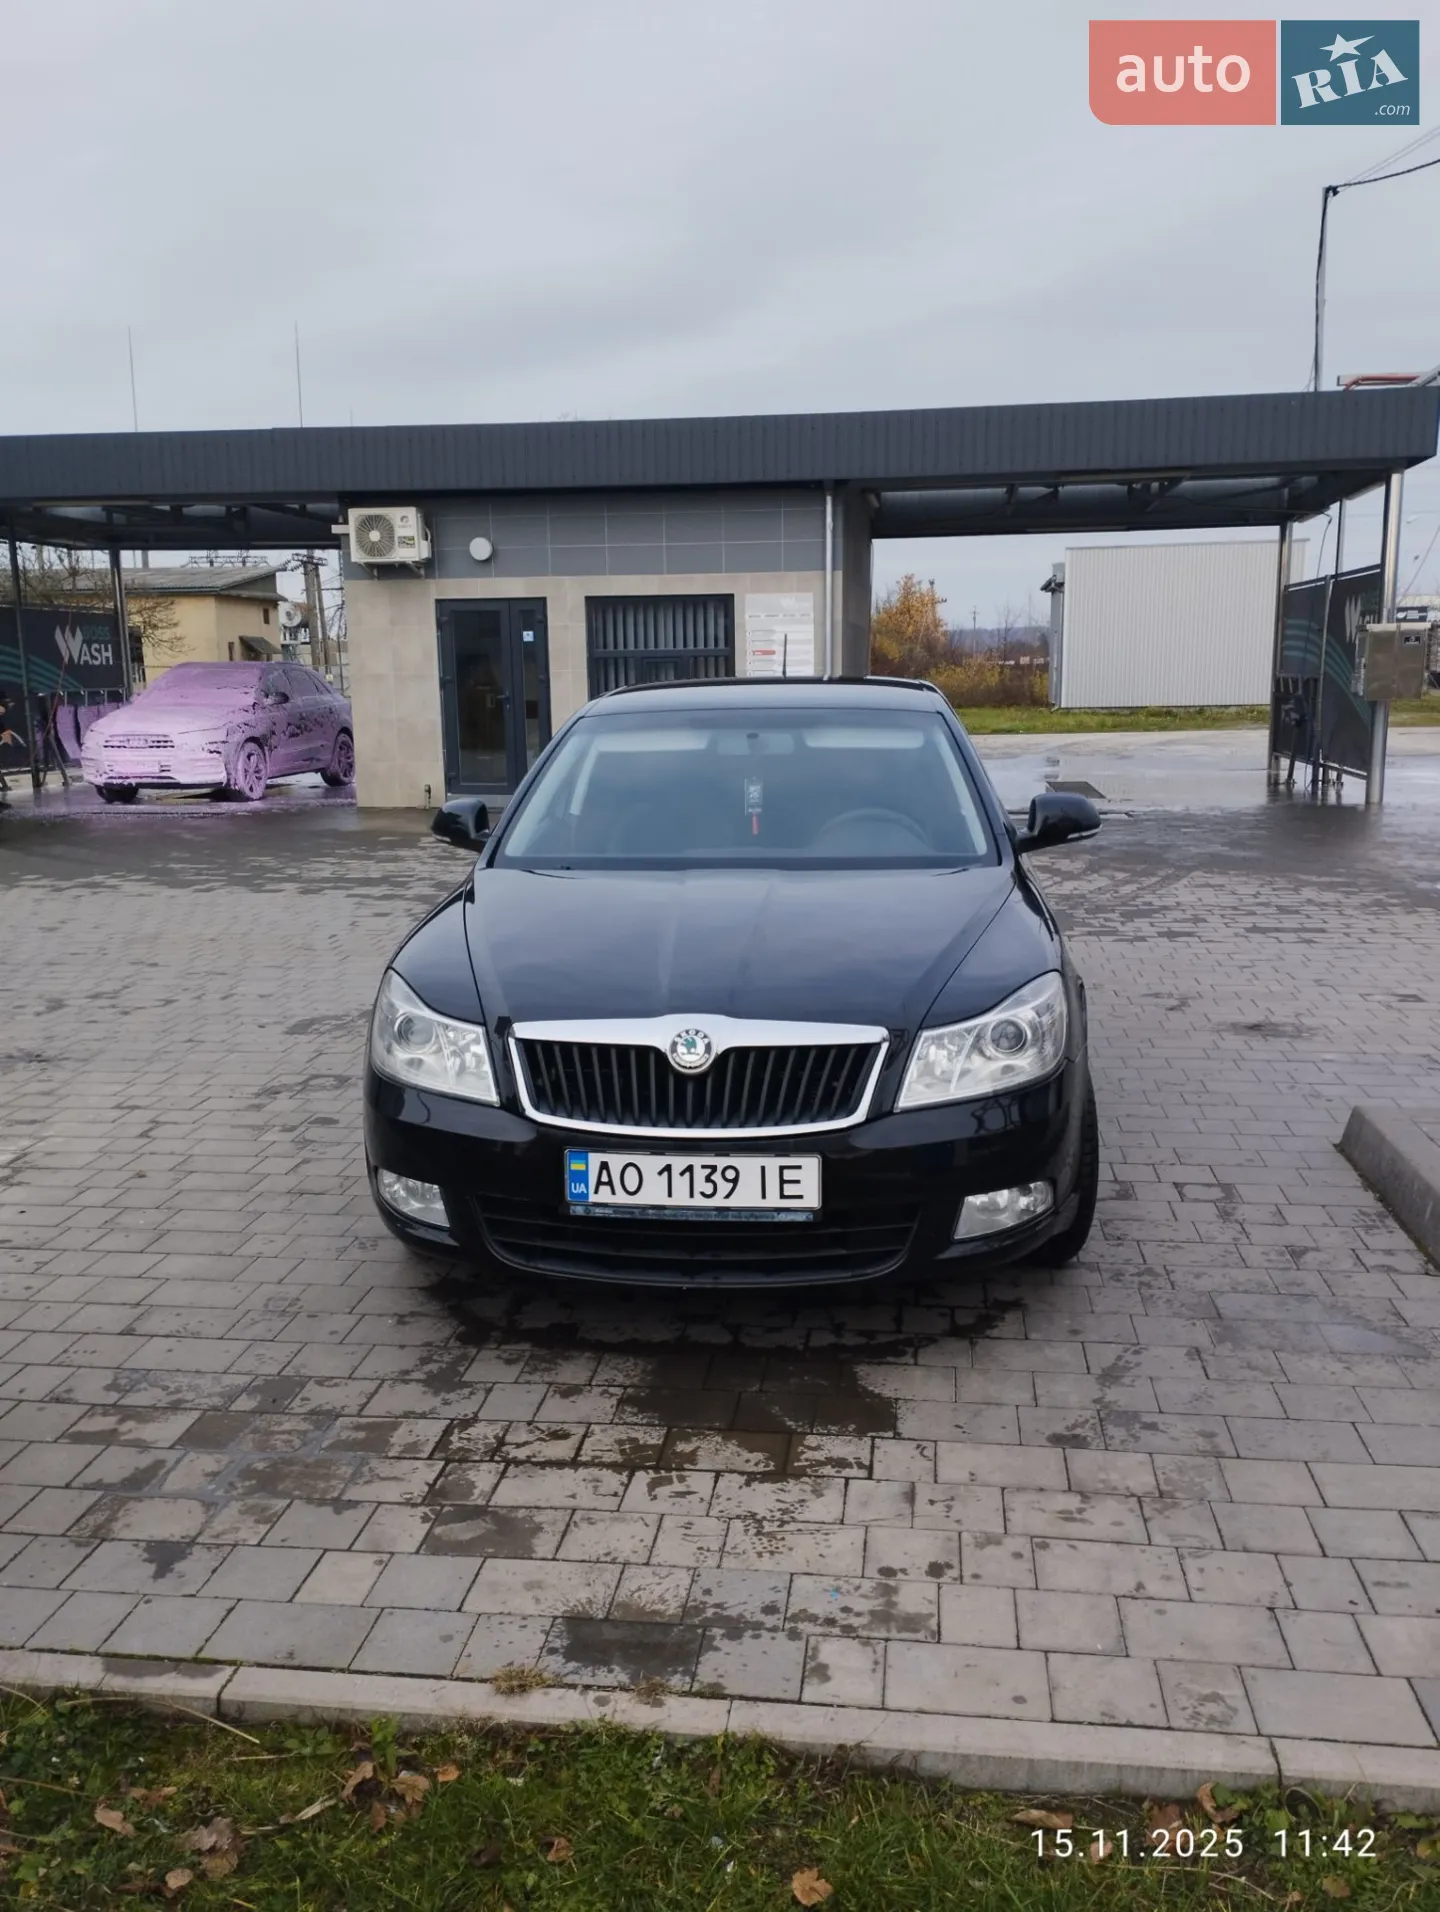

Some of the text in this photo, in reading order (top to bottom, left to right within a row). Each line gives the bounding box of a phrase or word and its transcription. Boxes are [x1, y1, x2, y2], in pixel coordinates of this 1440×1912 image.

[571, 1182, 587, 1194] UA
[593, 1160, 804, 1200] AO 1139 IE
